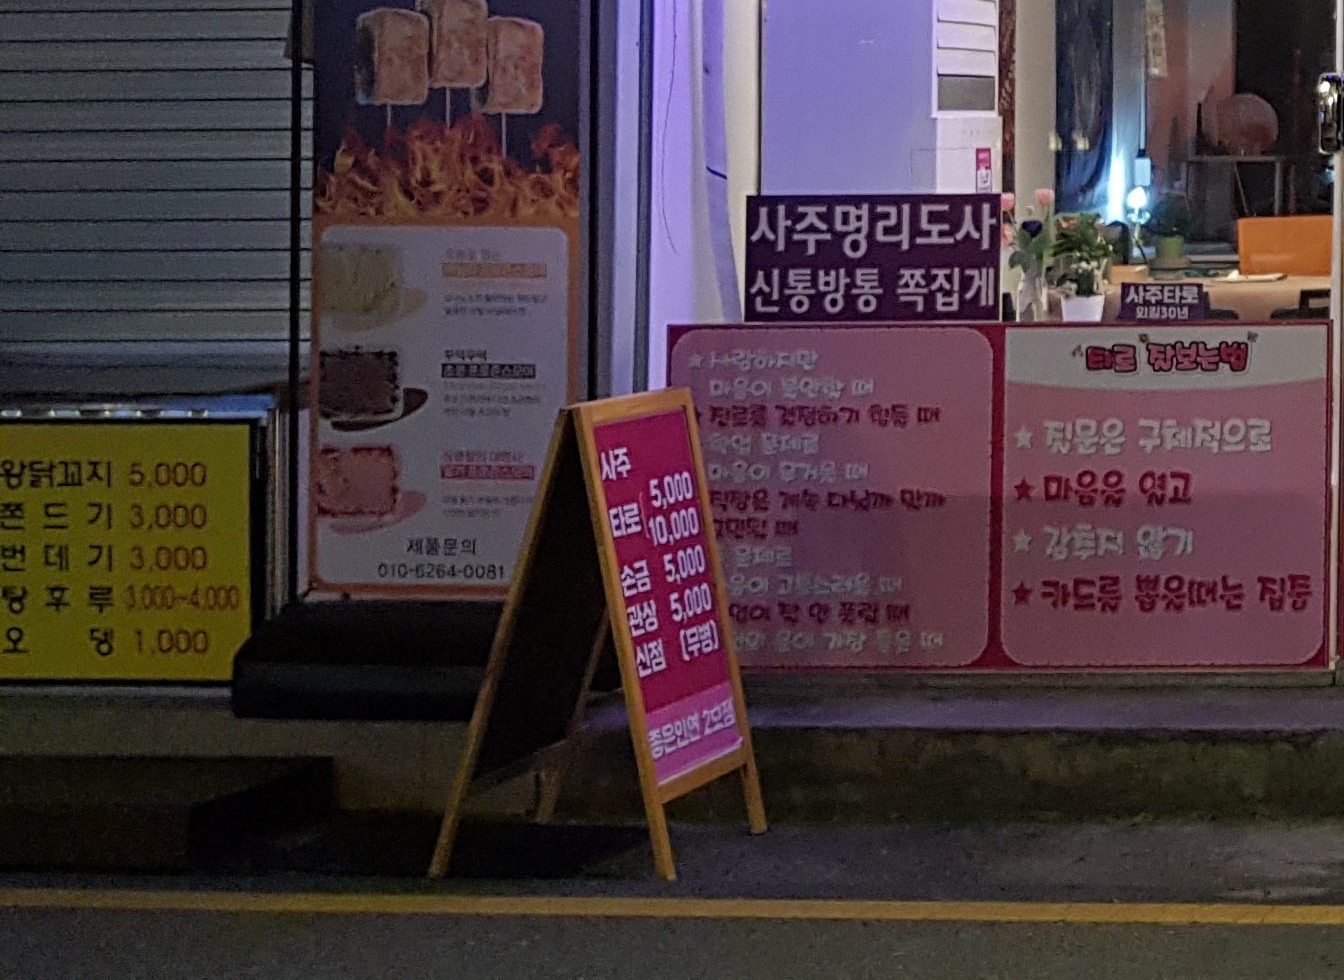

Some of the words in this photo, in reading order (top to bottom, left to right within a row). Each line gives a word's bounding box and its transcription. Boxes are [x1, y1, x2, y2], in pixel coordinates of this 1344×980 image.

[749, 201, 997, 258] 사주명리도사
[749, 267, 884, 316] 신통방통
[897, 265, 995, 315] 쪽집게
[1125, 284, 1199, 304] 사주타로
[1086, 344, 1137, 372] 타로
[1147, 340, 1249, 372] 잘보는법
[1044, 418, 1126, 455] 질문은
[1138, 418, 1272, 454] 구체적으로
[600, 447, 631, 481] 사주
[649, 471, 694, 508] 5,000
[1044, 470, 1126, 508] 마음을
[1139, 470, 1192, 506] 열고
[608, 502, 642, 538] 타로
[649, 506, 700, 546] 10,000
[620, 559, 651, 597] 손금
[664, 545, 706, 584] 5,000
[626, 600, 660, 637] 관상
[669, 582, 712, 623] 5,000
[1042, 575, 1121, 612] 카드를
[1257, 574, 1314, 612] 집중
[635, 638, 667, 678] 신점
